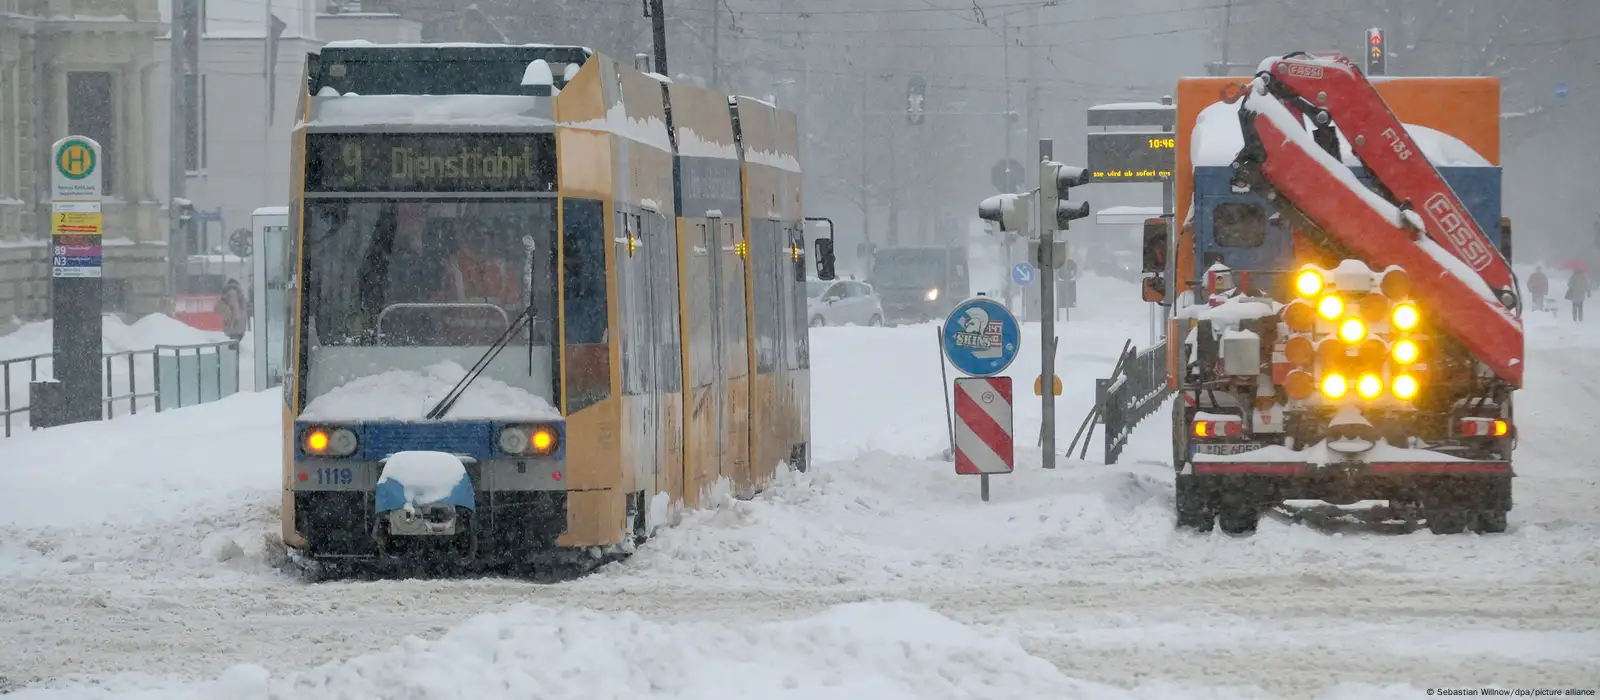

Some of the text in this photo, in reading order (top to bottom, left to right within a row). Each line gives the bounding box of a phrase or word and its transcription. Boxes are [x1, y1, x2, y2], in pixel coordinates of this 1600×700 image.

[1291, 66, 1321, 78] FASSI
[1149, 139, 1175, 148] 10:46
[67, 148, 85, 172] H
[342, 142, 533, 184] 9 Dienstfahrt
[1124, 169, 1133, 177] ab
[60, 213, 66, 223] 2
[1430, 198, 1487, 266] FASSI
[54, 246, 66, 256] 89
[54, 257, 66, 266] N3
[317, 467, 353, 485] 1119
